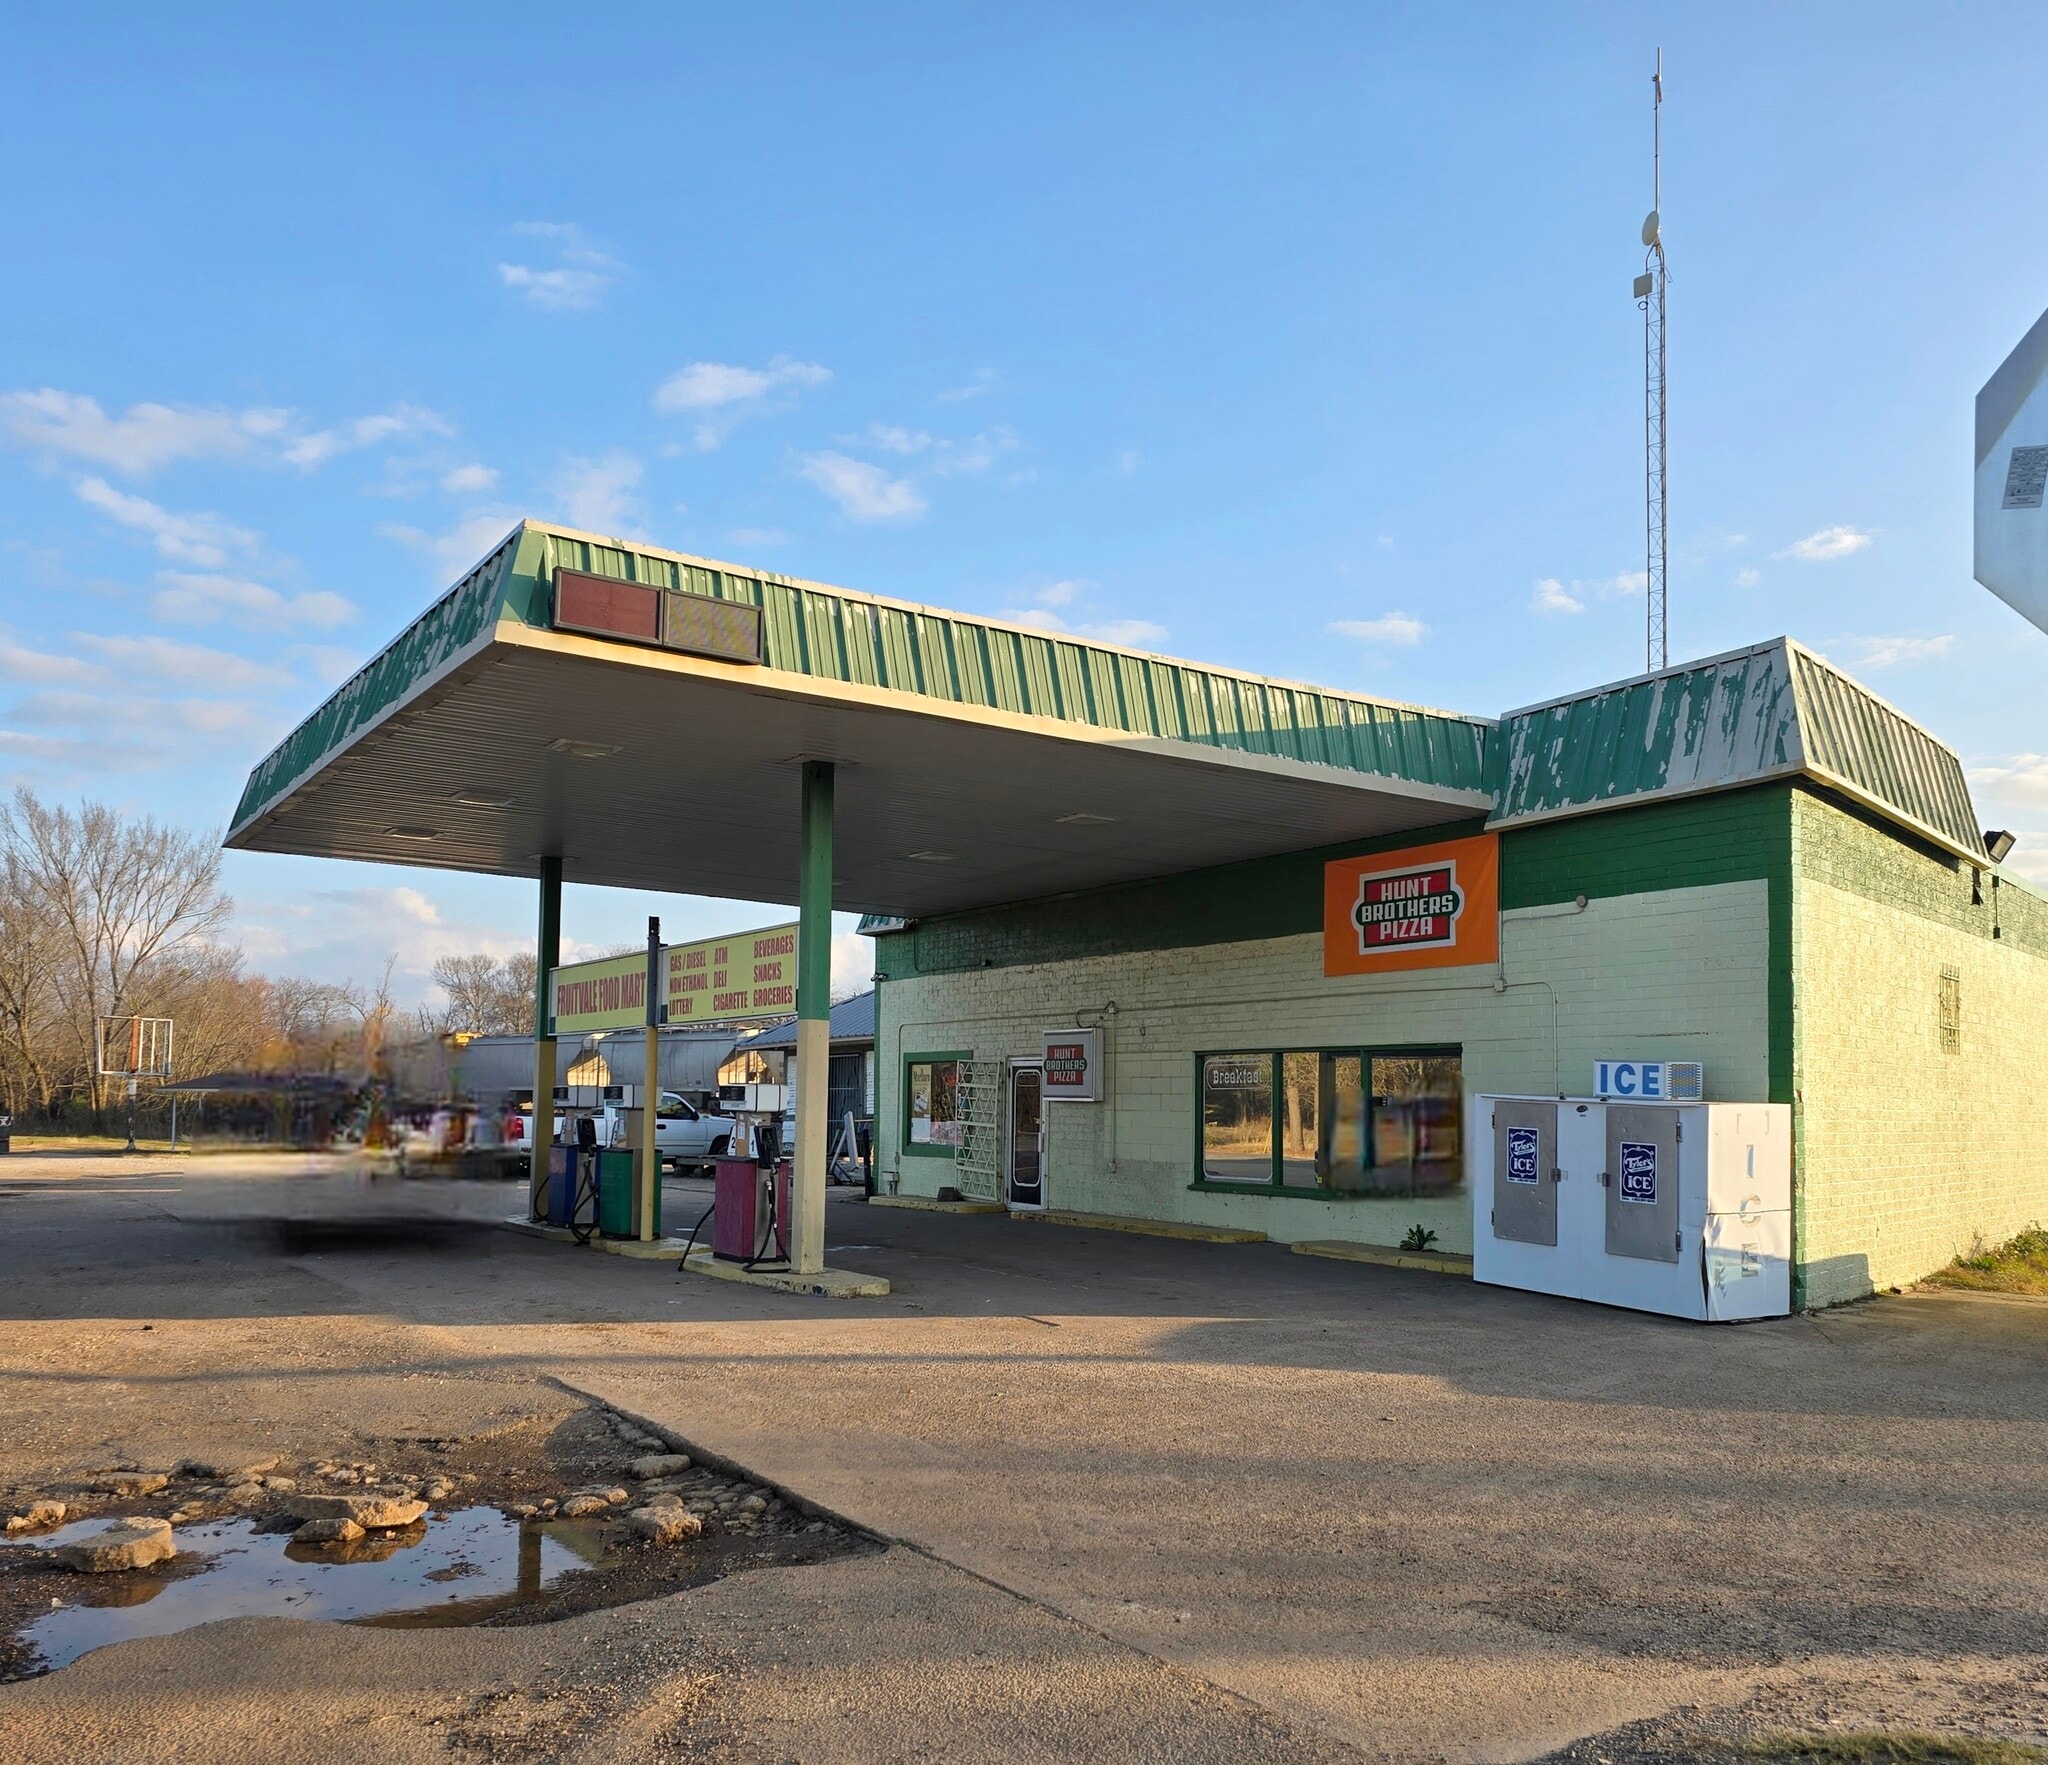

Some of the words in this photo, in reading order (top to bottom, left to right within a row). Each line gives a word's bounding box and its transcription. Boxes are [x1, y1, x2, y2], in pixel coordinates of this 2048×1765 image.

[1381, 877, 1431, 902] HUNT
[1361, 895, 1453, 923] BROTHERS
[1380, 916, 1432, 940] PIZZA
[714, 946, 728, 965] ATM
[753, 934, 794, 959] BEVERAGES
[670, 954, 682, 972] GAS
[687, 950, 706, 969] DIESEL
[713, 970, 727, 988] DELI
[753, 961, 782, 983] SNACKS
[557, 980, 597, 1017] FRUITVALE
[599, 976, 620, 1012] FOOD
[621, 971, 646, 1009] MART
[669, 975, 681, 994] NON
[682, 973, 708, 992] ETHANOL
[669, 997, 693, 1016] LOTTERY
[713, 990, 748, 1011] CIGARETTE
[753, 985, 793, 1007] GROCERIES
[1054, 1048, 1076, 1059] HUNT
[1046, 1059, 1085, 1071] BROTHERS
[1053, 1070, 1076, 1082] PIZZA
[1212, 1068, 1263, 1085] Breakfast
[1600, 1063, 1660, 1096] ICE
[1513, 1158, 1534, 1171] ICE
[1628, 1175, 1652, 1190] ICE
